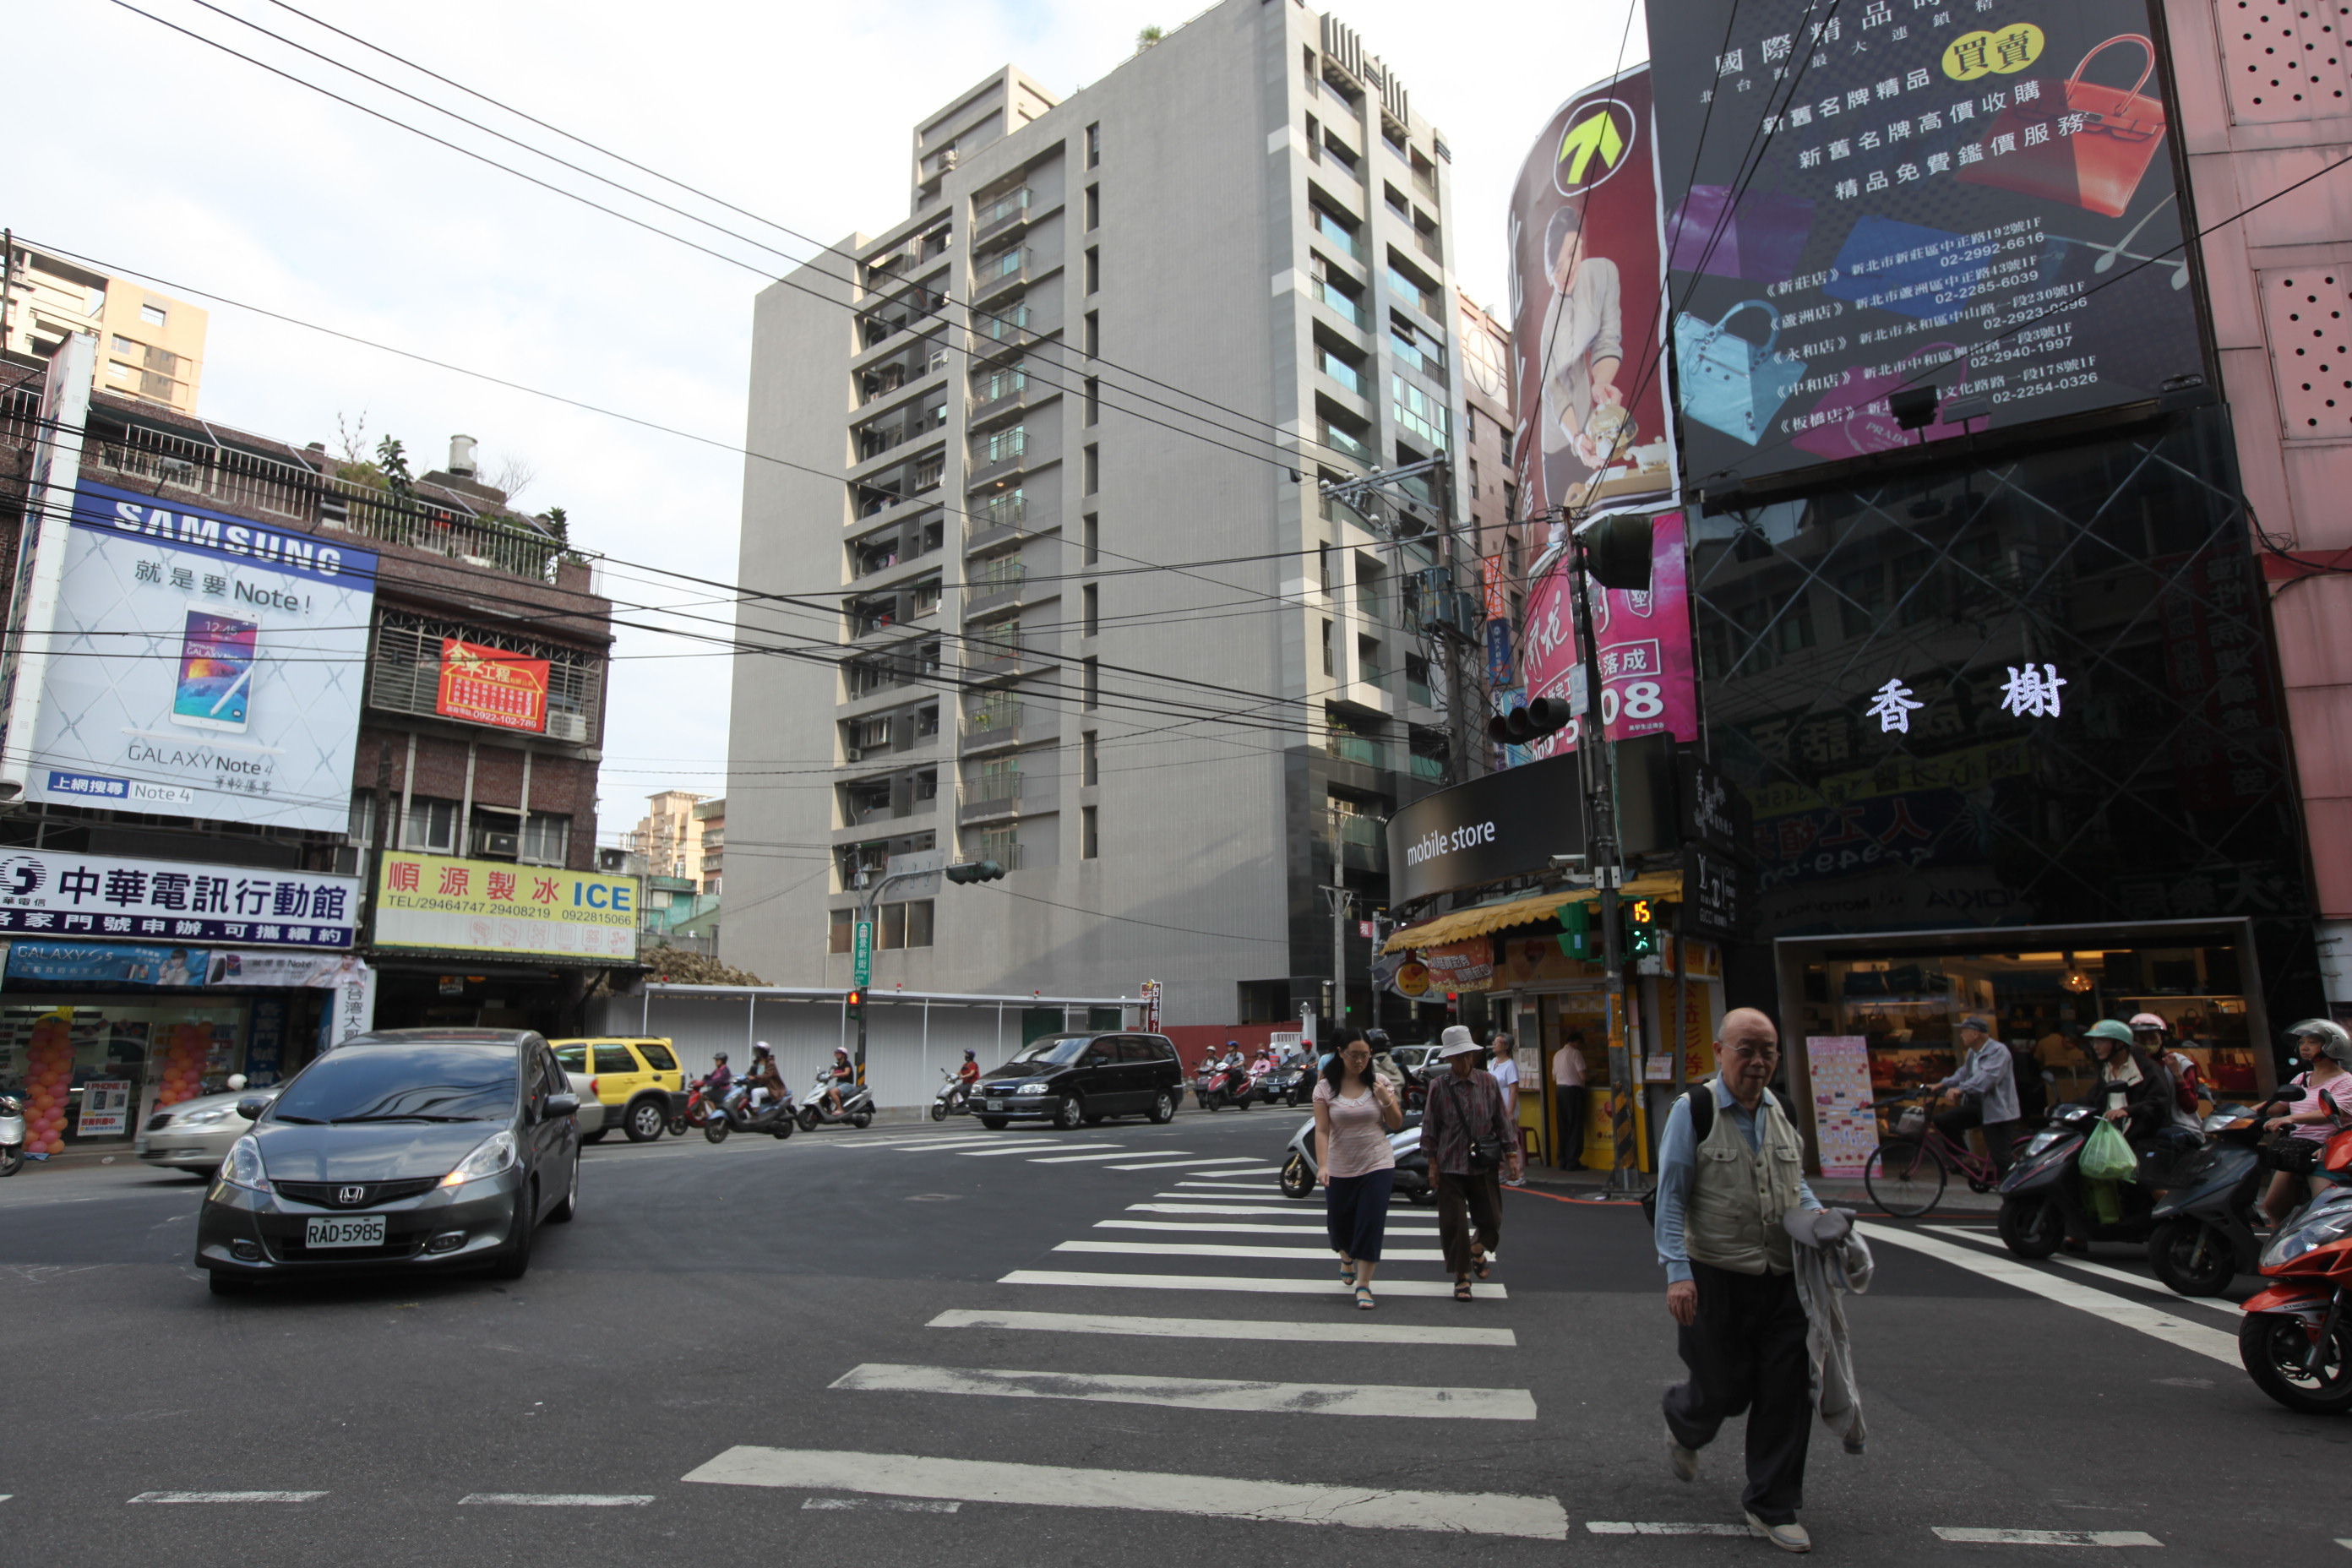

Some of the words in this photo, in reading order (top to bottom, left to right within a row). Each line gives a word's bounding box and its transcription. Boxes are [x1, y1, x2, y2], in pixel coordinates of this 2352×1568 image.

[1763, 68, 1930, 135] 新舊名牌精品
[1953, 30, 2030, 78] 買賣
[1799, 80, 2040, 169] 新舊名牌高價收購
[1835, 113, 2083, 200] 精品免費鑑價服務
[1941, 231, 2044, 267] 02-2992-6616
[1935, 270, 2039, 304] 02-2285-6039
[1971, 336, 2072, 368] 02-2940-1997
[1993, 373, 2098, 403] 02-2254-0326
[114, 500, 340, 576] SAMSUNG
[134, 559, 228, 596] 就是要
[473, 710, 536, 728] 0922-102-789
[128, 744, 213, 769] GALAXY
[216, 756, 261, 775] Note
[52, 776, 124, 797] 上網搜尋
[134, 785, 175, 800] Note
[180, 790, 190, 802] 4
[1407, 830, 1448, 867] mobile
[1451, 820, 1495, 852] store
[58, 866, 347, 921] 中華電訊行動館
[387, 861, 560, 904] 順源製冰
[574, 881, 630, 912] ICE
[562, 910, 631, 925] 0922815066
[1634, 900, 1652, 923] 15
[18, 945, 85, 960] GALAXY
[308, 1222, 384, 1244] RAD-5985
